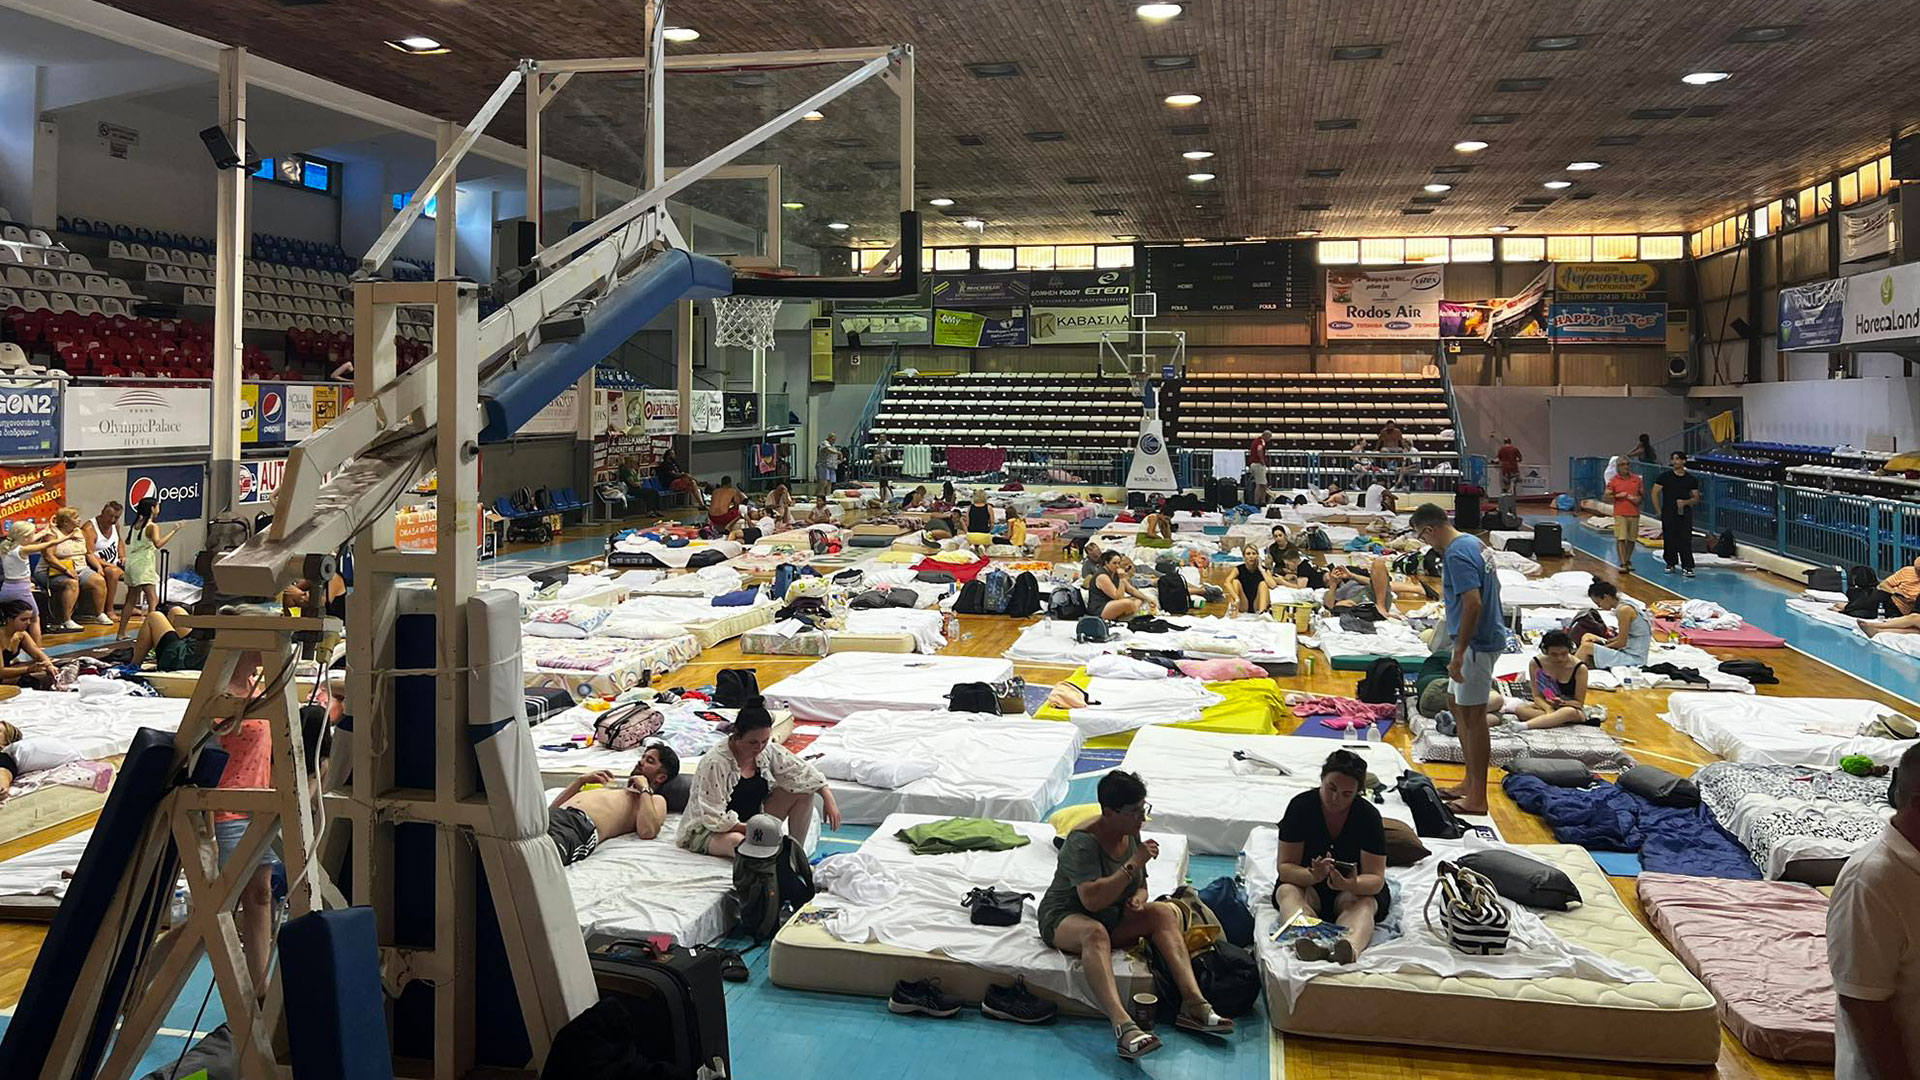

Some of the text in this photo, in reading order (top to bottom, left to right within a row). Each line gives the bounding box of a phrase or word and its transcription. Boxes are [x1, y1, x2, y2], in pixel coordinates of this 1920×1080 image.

[1415, 276, 1437, 287] vitex
[1059, 288, 1081, 296] ΡΟΔΟΥ
[1084, 285, 1130, 295] ETEM
[1346, 305, 1391, 319] Rodos
[1555, 313, 1602, 327] HAPPY
[1855, 307, 1920, 336] HorecaLand
[852, 355, 859, 363] 5
[263, 424, 280, 434] pepsi
[124, 438, 157, 446] HOTEL
[158, 482, 198, 504] pepsi
